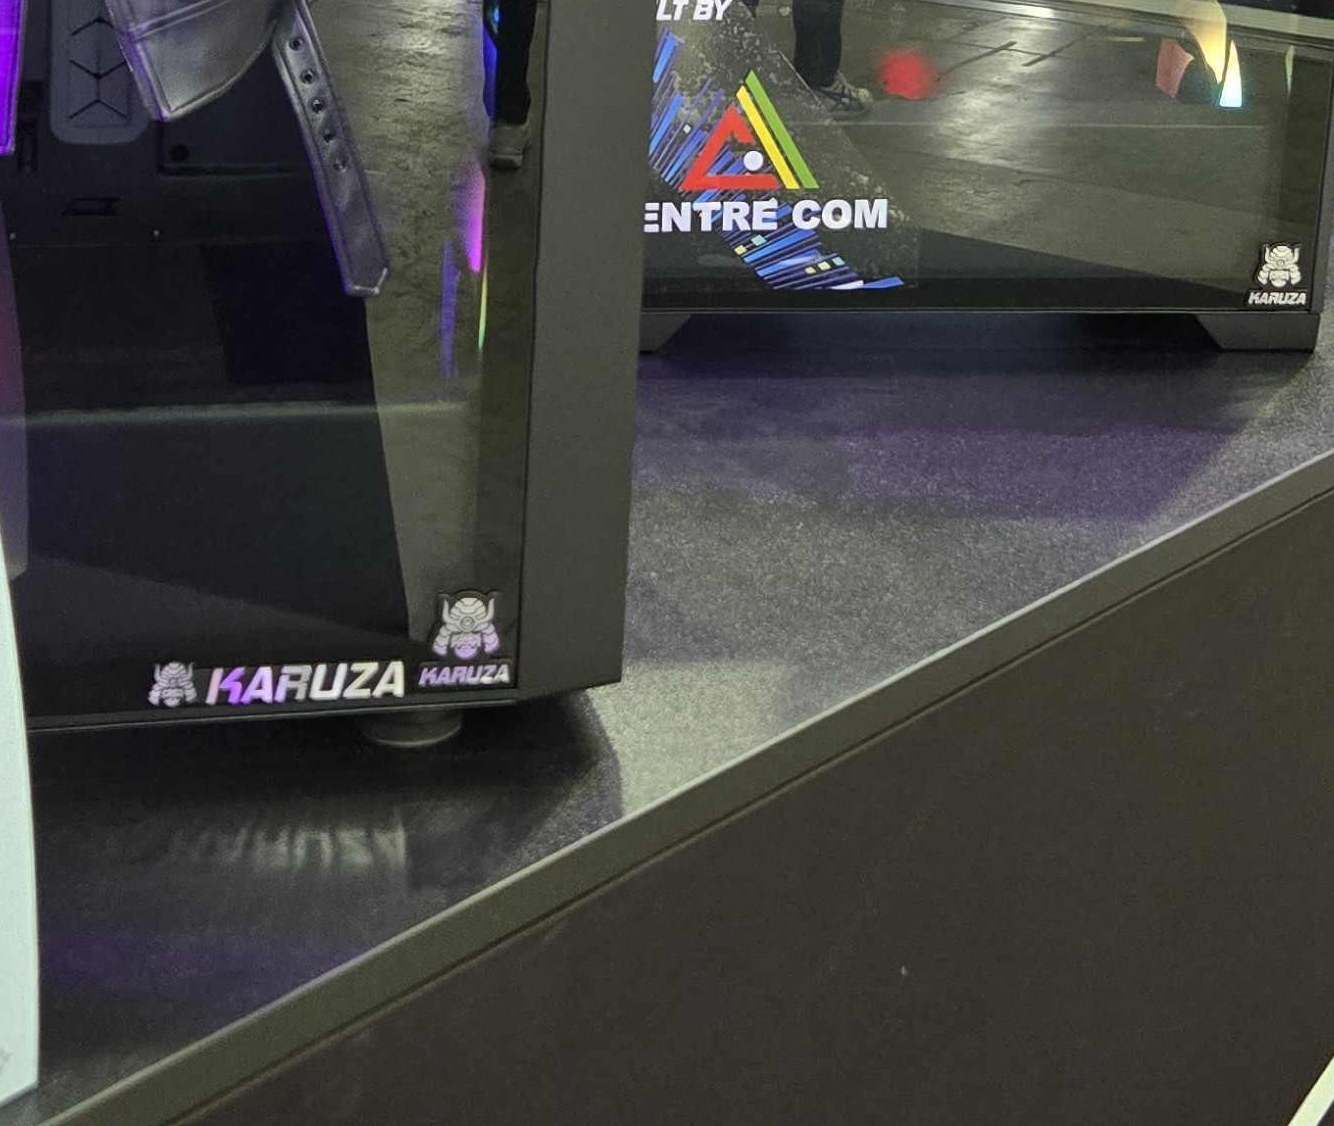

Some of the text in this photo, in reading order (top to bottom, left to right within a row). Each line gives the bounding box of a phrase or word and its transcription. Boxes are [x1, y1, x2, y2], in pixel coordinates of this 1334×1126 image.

[791, 198, 888, 231] COM
[1248, 292, 1307, 305] KARUZA
[205, 660, 405, 705] KARUZA
[418, 663, 510, 687] KARUZA
